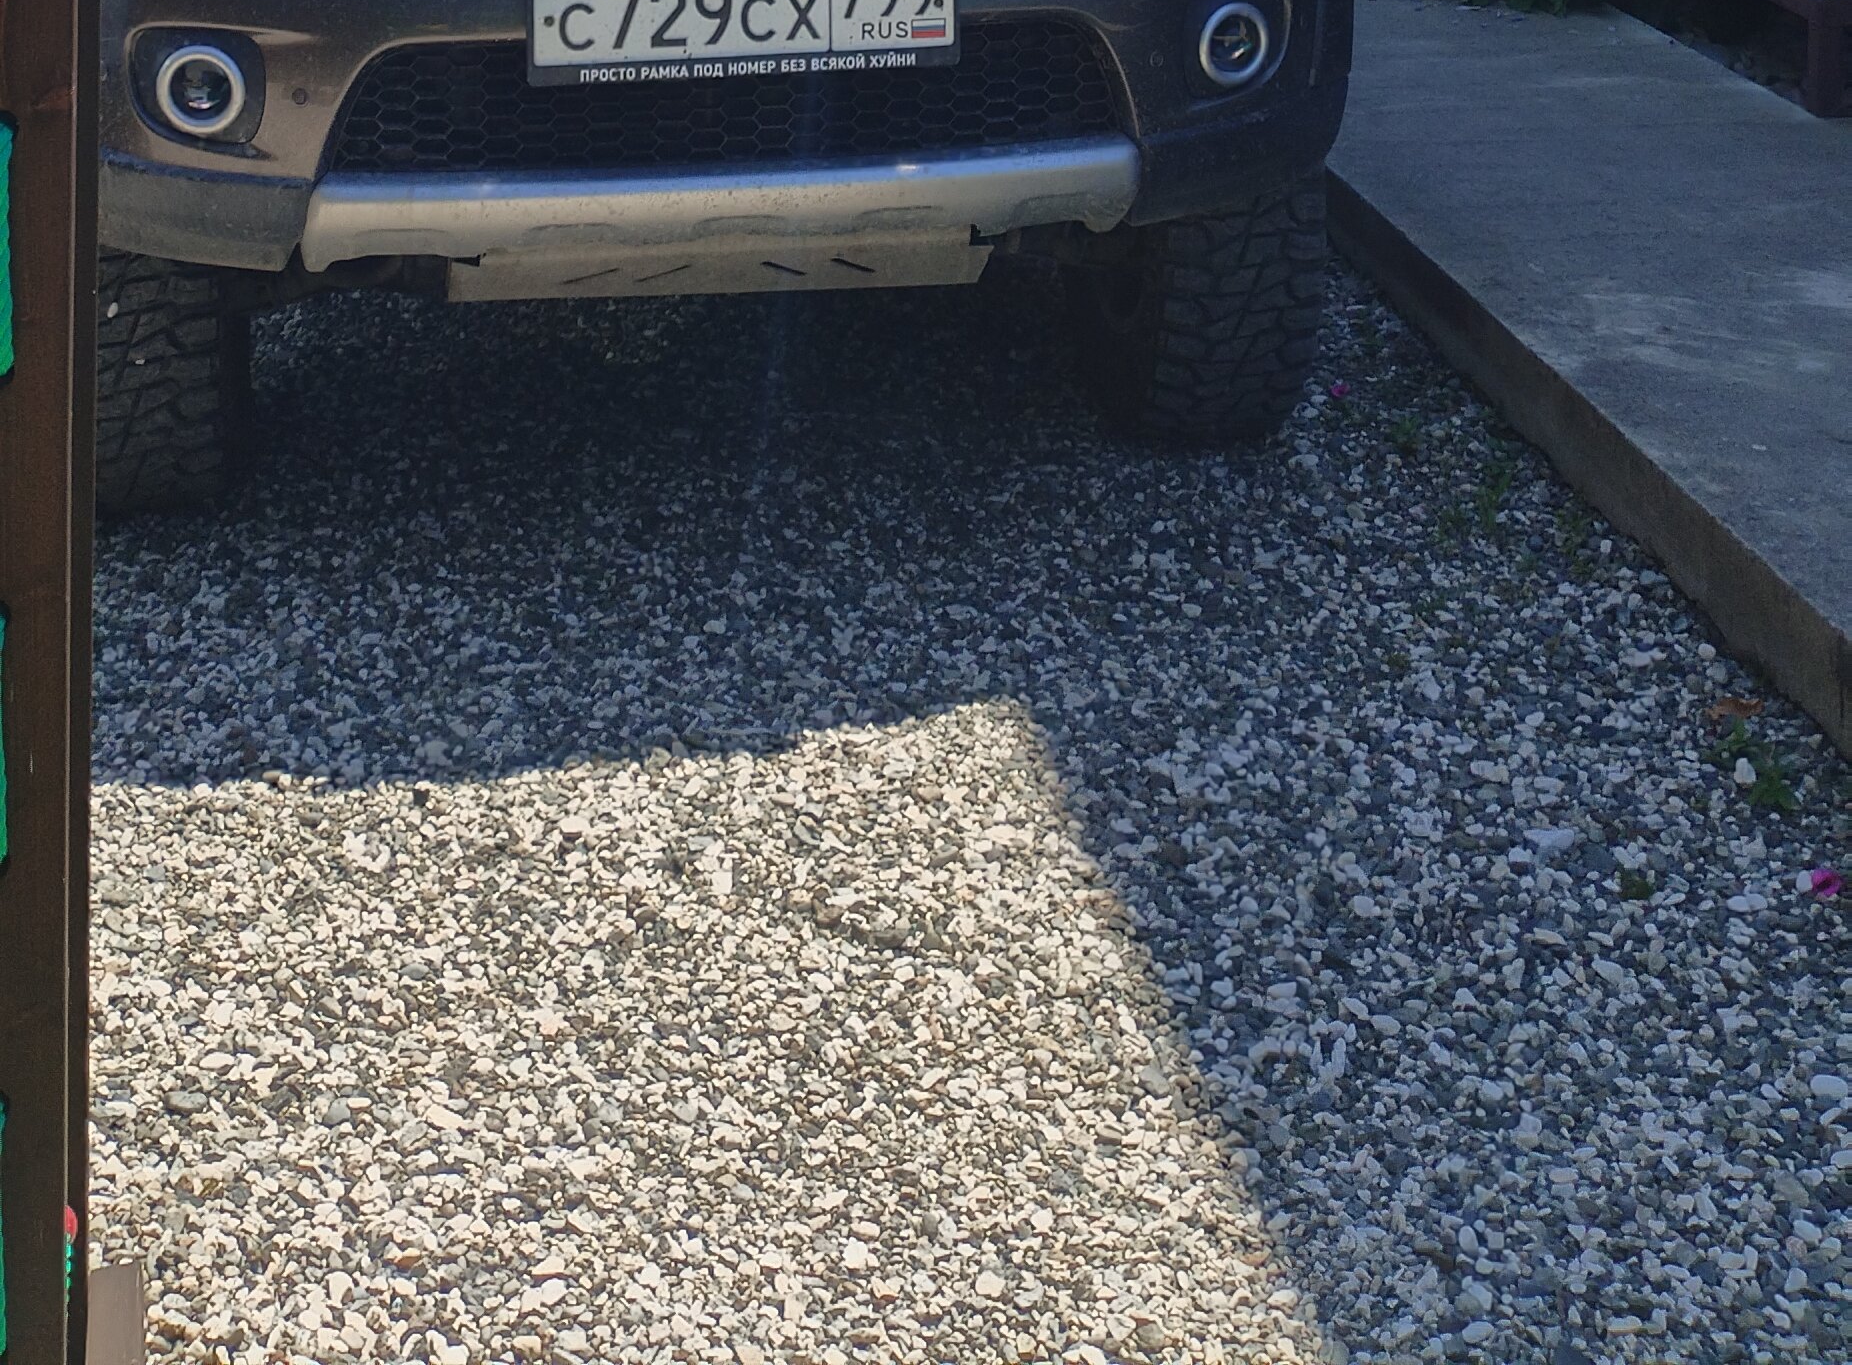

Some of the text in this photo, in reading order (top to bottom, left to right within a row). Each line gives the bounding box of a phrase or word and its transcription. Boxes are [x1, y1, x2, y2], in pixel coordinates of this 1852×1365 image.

[861, 20, 909, 40] RUS
[579, 51, 917, 83] ПРОСТО РАМКА ПОД НОМЕР БЕЗ ВСЯКОЙ ХУЙНИ
